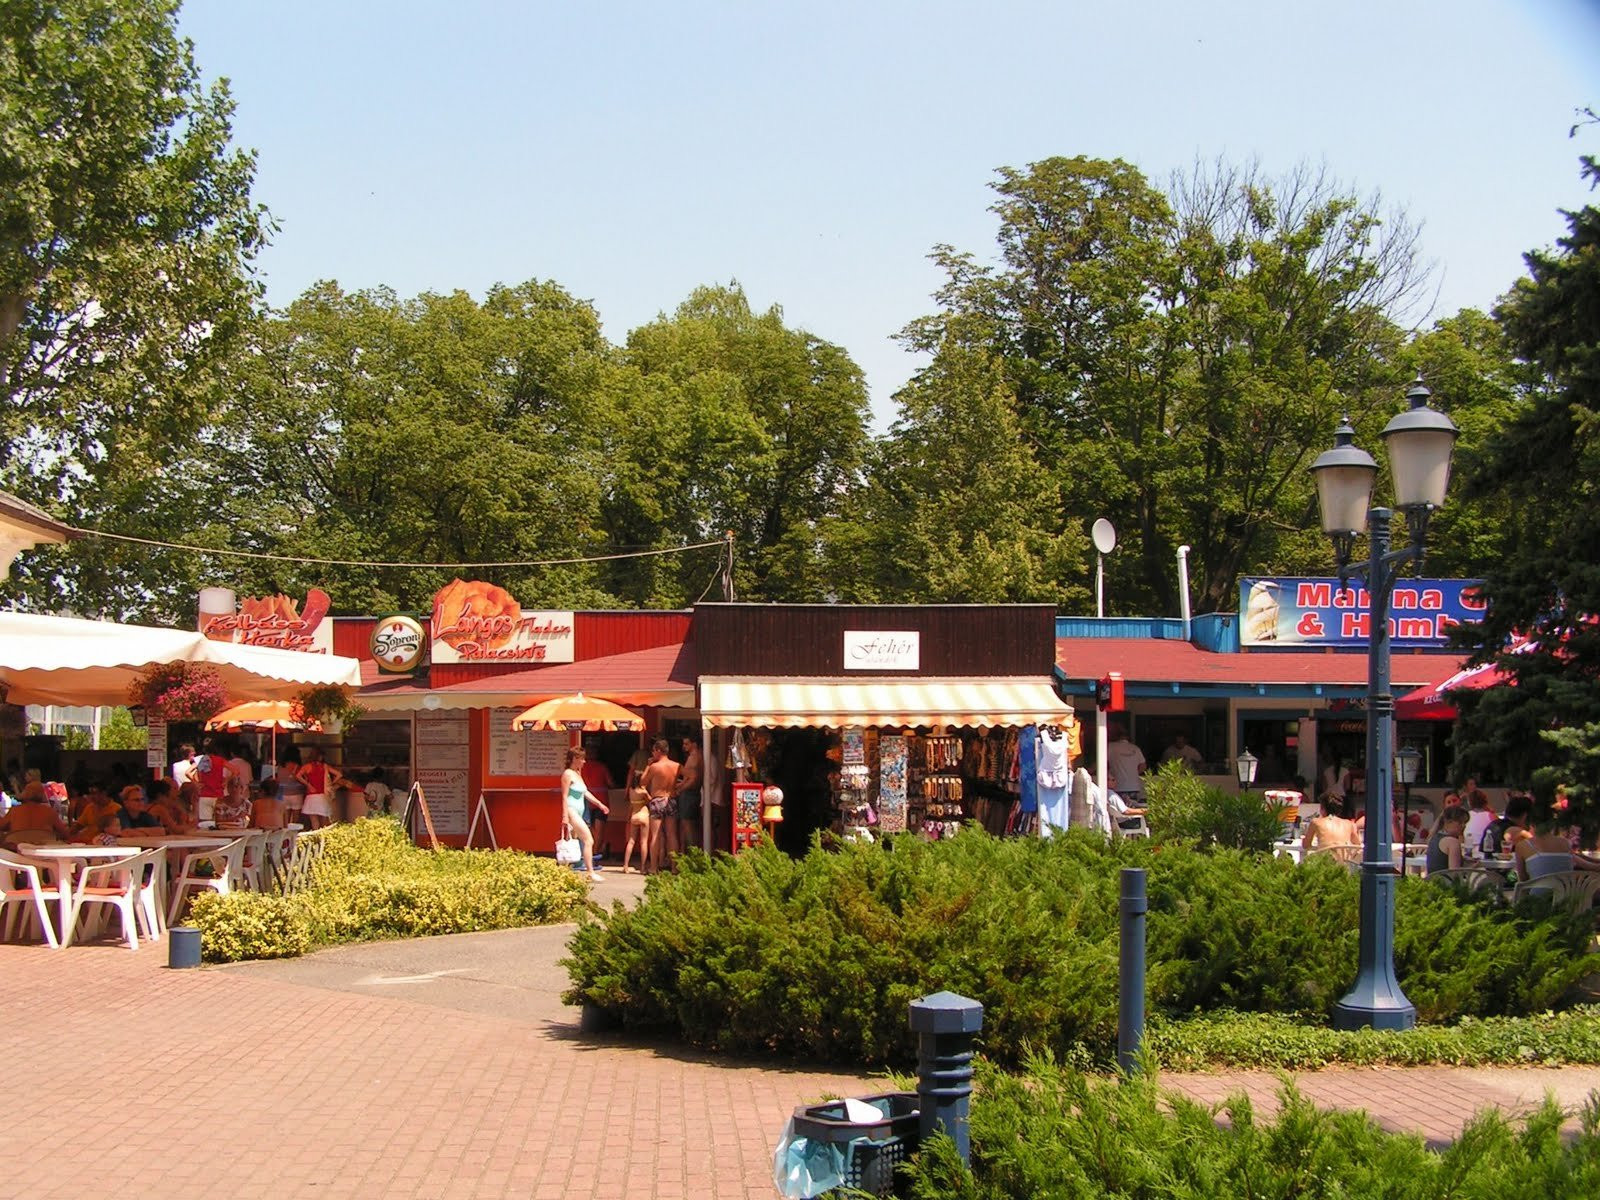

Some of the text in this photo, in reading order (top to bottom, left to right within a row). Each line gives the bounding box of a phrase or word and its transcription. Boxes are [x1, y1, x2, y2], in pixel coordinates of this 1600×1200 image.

[433, 602, 513, 640] Lángos
[1297, 613, 1324, 637] &
[373, 632, 421, 656] Soproni
[457, 641, 546, 659] Palacsinta
